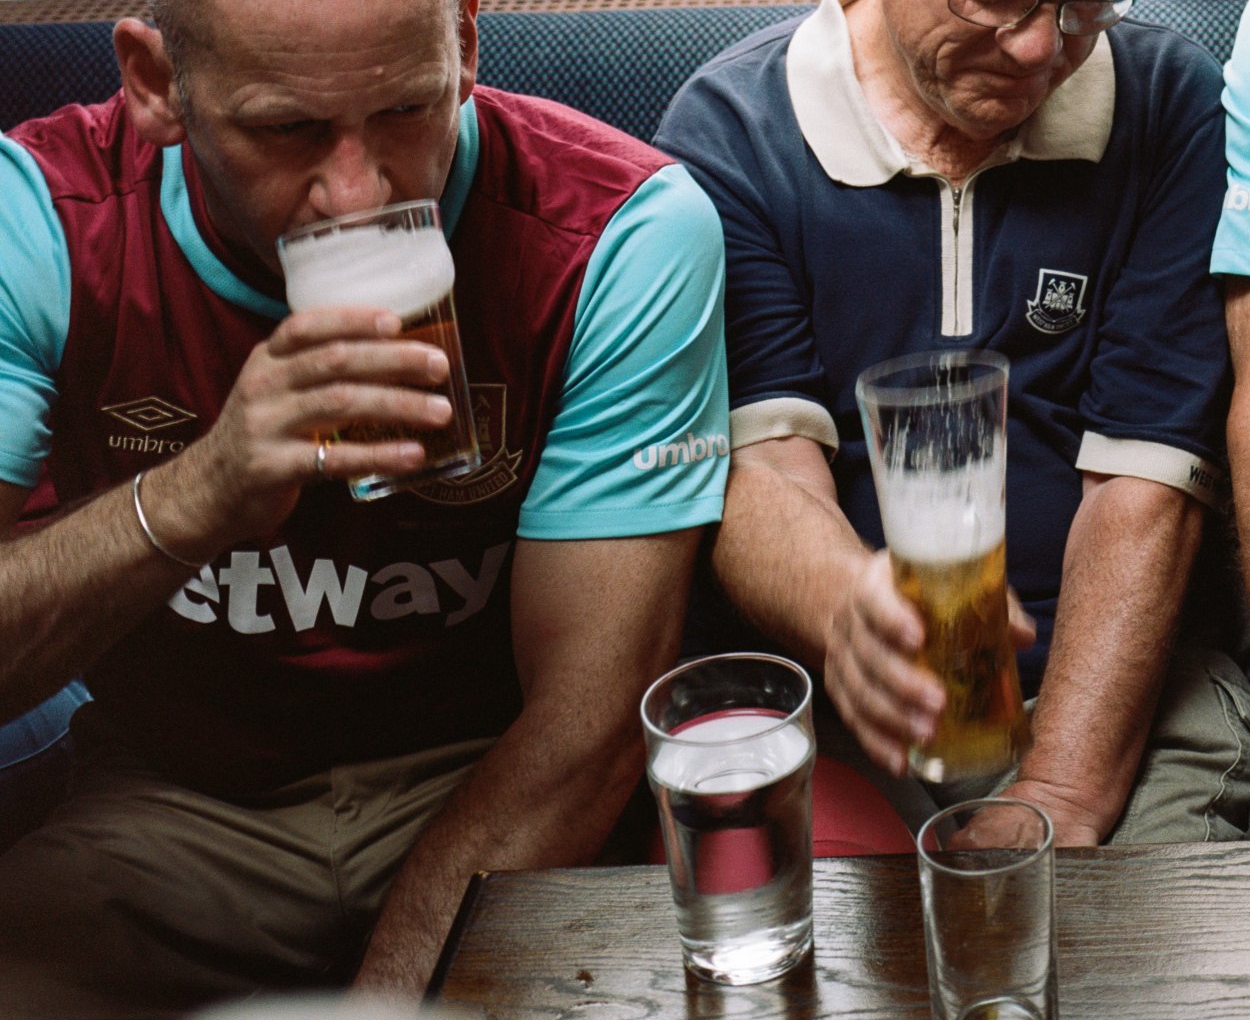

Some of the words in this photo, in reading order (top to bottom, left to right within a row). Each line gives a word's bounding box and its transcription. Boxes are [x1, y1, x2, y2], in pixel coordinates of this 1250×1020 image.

[109, 434, 184, 454] umbro
[633, 432, 729, 470] umbro
[168, 541, 511, 634] etway
